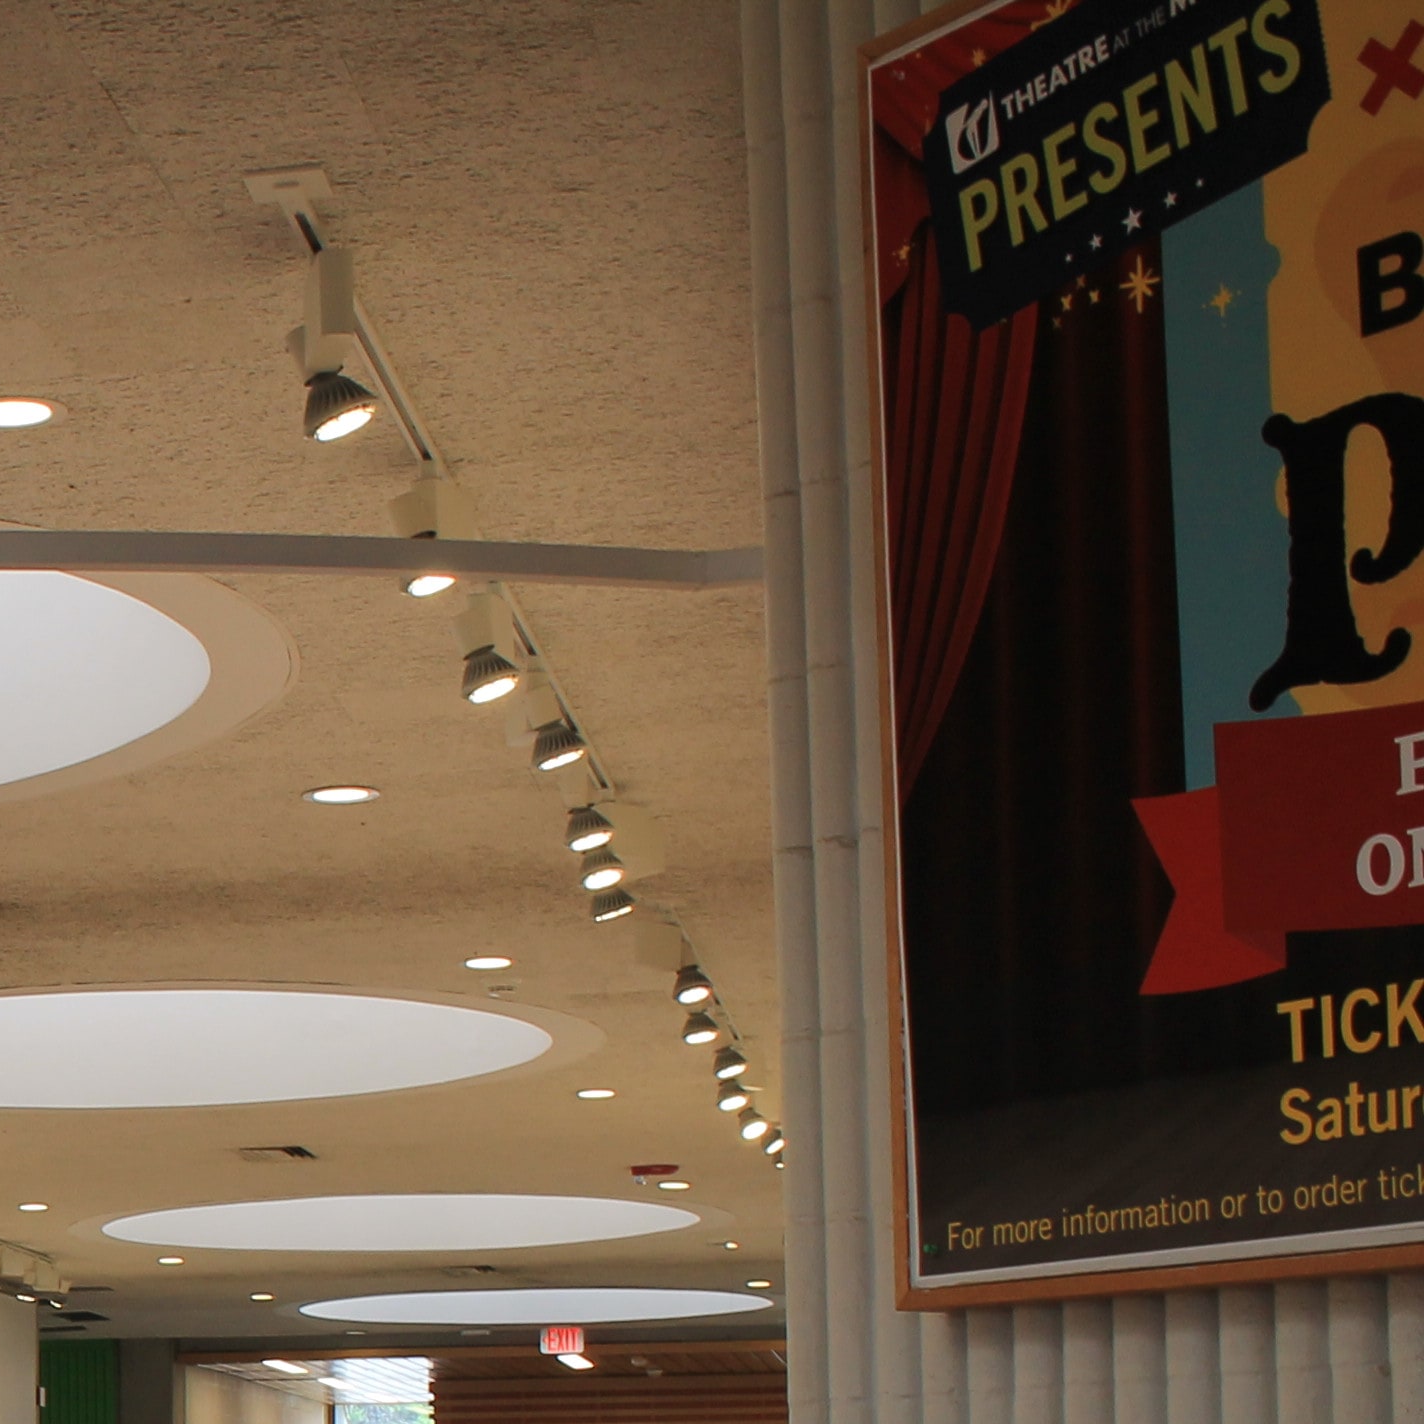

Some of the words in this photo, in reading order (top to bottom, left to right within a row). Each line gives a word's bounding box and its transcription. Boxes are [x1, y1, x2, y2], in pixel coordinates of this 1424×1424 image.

[1001, 34, 1111, 121] THEATRE
[1112, 28, 1132, 54] AT
[1135, 5, 1167, 37] THE
[958, 0, 1302, 273] PRESENTS
[1276, 978, 1424, 1063] TICK
[1279, 1081, 1424, 1145] Satur
[947, 1221, 984, 1251] For
[993, 1214, 1052, 1246] more
[1063, 1195, 1210, 1238] information
[1220, 1191, 1247, 1219] or
[1256, 1185, 1283, 1215] to
[1293, 1174, 1367, 1209] order
[548, 1328, 580, 1352] EXIT
